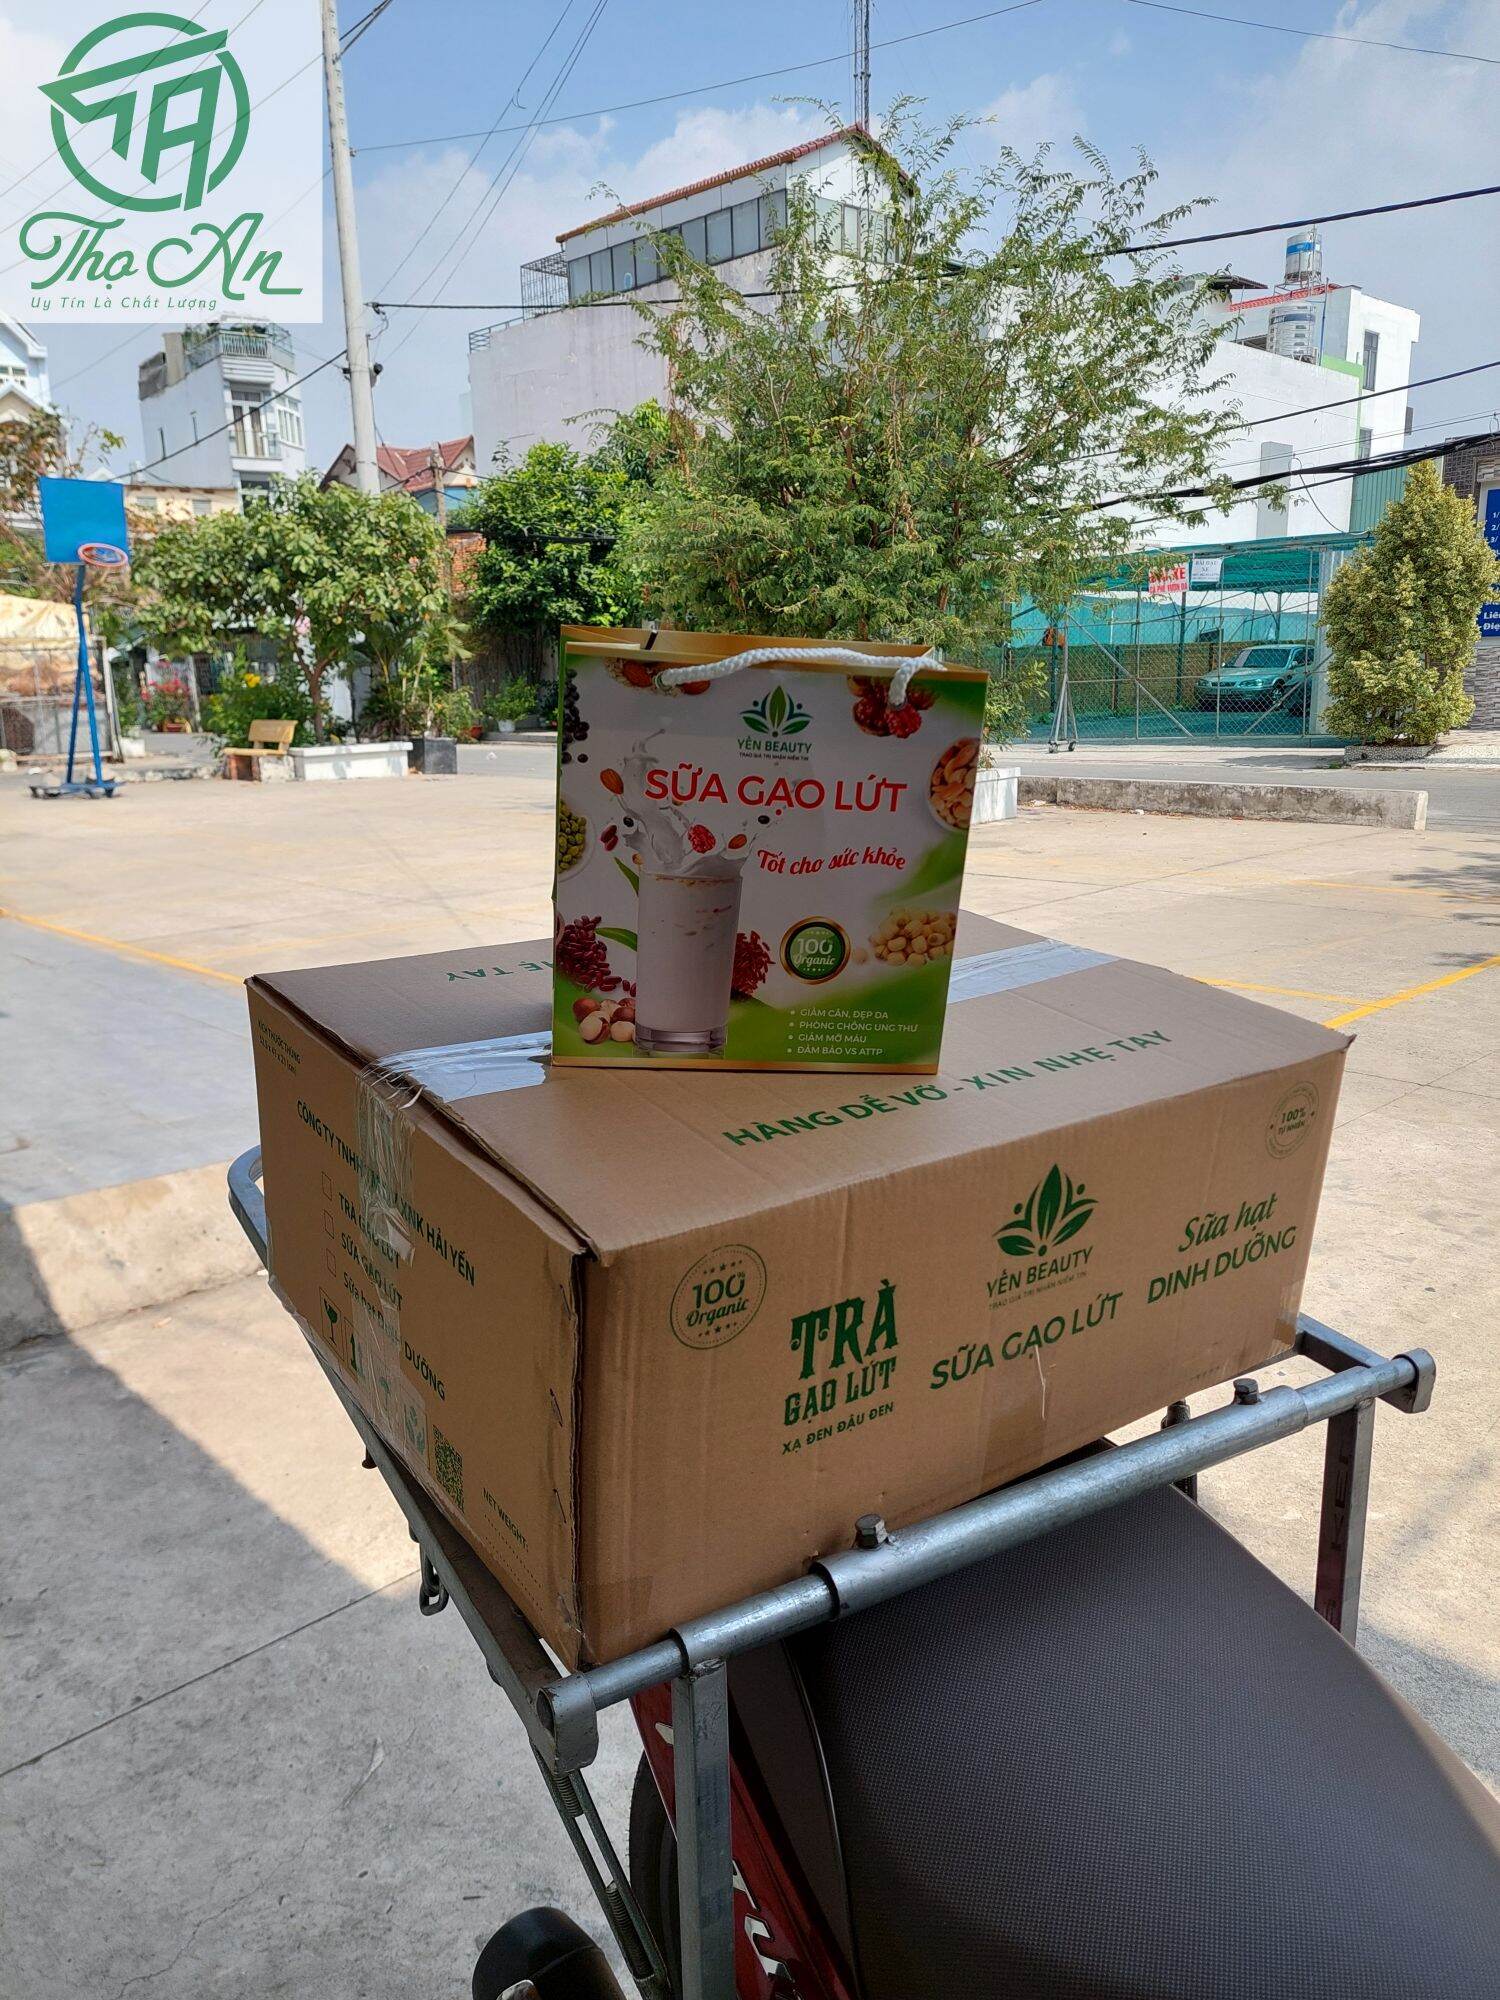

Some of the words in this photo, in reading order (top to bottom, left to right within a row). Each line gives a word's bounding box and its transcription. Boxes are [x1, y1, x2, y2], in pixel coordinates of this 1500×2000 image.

[765, 741, 812, 753] BEAUTY
[645, 763, 728, 804] SỮA
[737, 775, 825, 816] GẠO
[834, 774, 907, 812] LỨT
[757, 849, 785, 874] Tốt
[790, 856, 825, 874] cho
[828, 848, 858, 870] sức
[861, 846, 906, 870] khỏe
[446, 966, 514, 982] TAY
[793, 954, 836, 968] Organic
[875, 1011, 889, 1019] DA
[845, 1047, 857, 1055] VS
[859, 1047, 883, 1056] ATTP
[722, 1110, 842, 1146] HÀNG
[839, 1094, 898, 1121] DỄ
[889, 1084, 948, 1106] VỠ
[961, 1066, 1036, 1090] XIN
[1033, 1046, 1117, 1073] NHẸ
[1106, 1030, 1173, 1052] TAY
[297, 1100, 322, 1137] CÔNG
[323, 1124, 335, 1148] TY
[427, 1224, 448, 1260] HẢI
[450, 1244, 475, 1286] YẾN
[338, 1192, 356, 1224] TRÀ
[1178, 1212, 1228, 1253] Sữa
[1234, 1192, 1278, 1232] hạt
[341, 1232, 360, 1265] SỮA
[987, 1269, 1022, 1297] YẾN
[1027, 1246, 1093, 1284] BEAUTY
[1147, 1259, 1210, 1304] DINH
[1214, 1226, 1297, 1276] DƯỠNG
[686, 1299, 749, 1327] Organic
[790, 1278, 898, 1380] TRÀ
[929, 1343, 994, 1390] SỮA
[1002, 1316, 1065, 1360] GẠO
[1071, 1292, 1123, 1335] LỨT
[404, 1341, 445, 1401] DƯỠNG
[784, 1379, 837, 1426] GẠO
[782, 1438, 801, 1455] XẠ
[806, 1428, 832, 1445] ĐEN
[836, 1413, 865, 1432] ĐẬU
[869, 1402, 894, 1419] ĐEN
